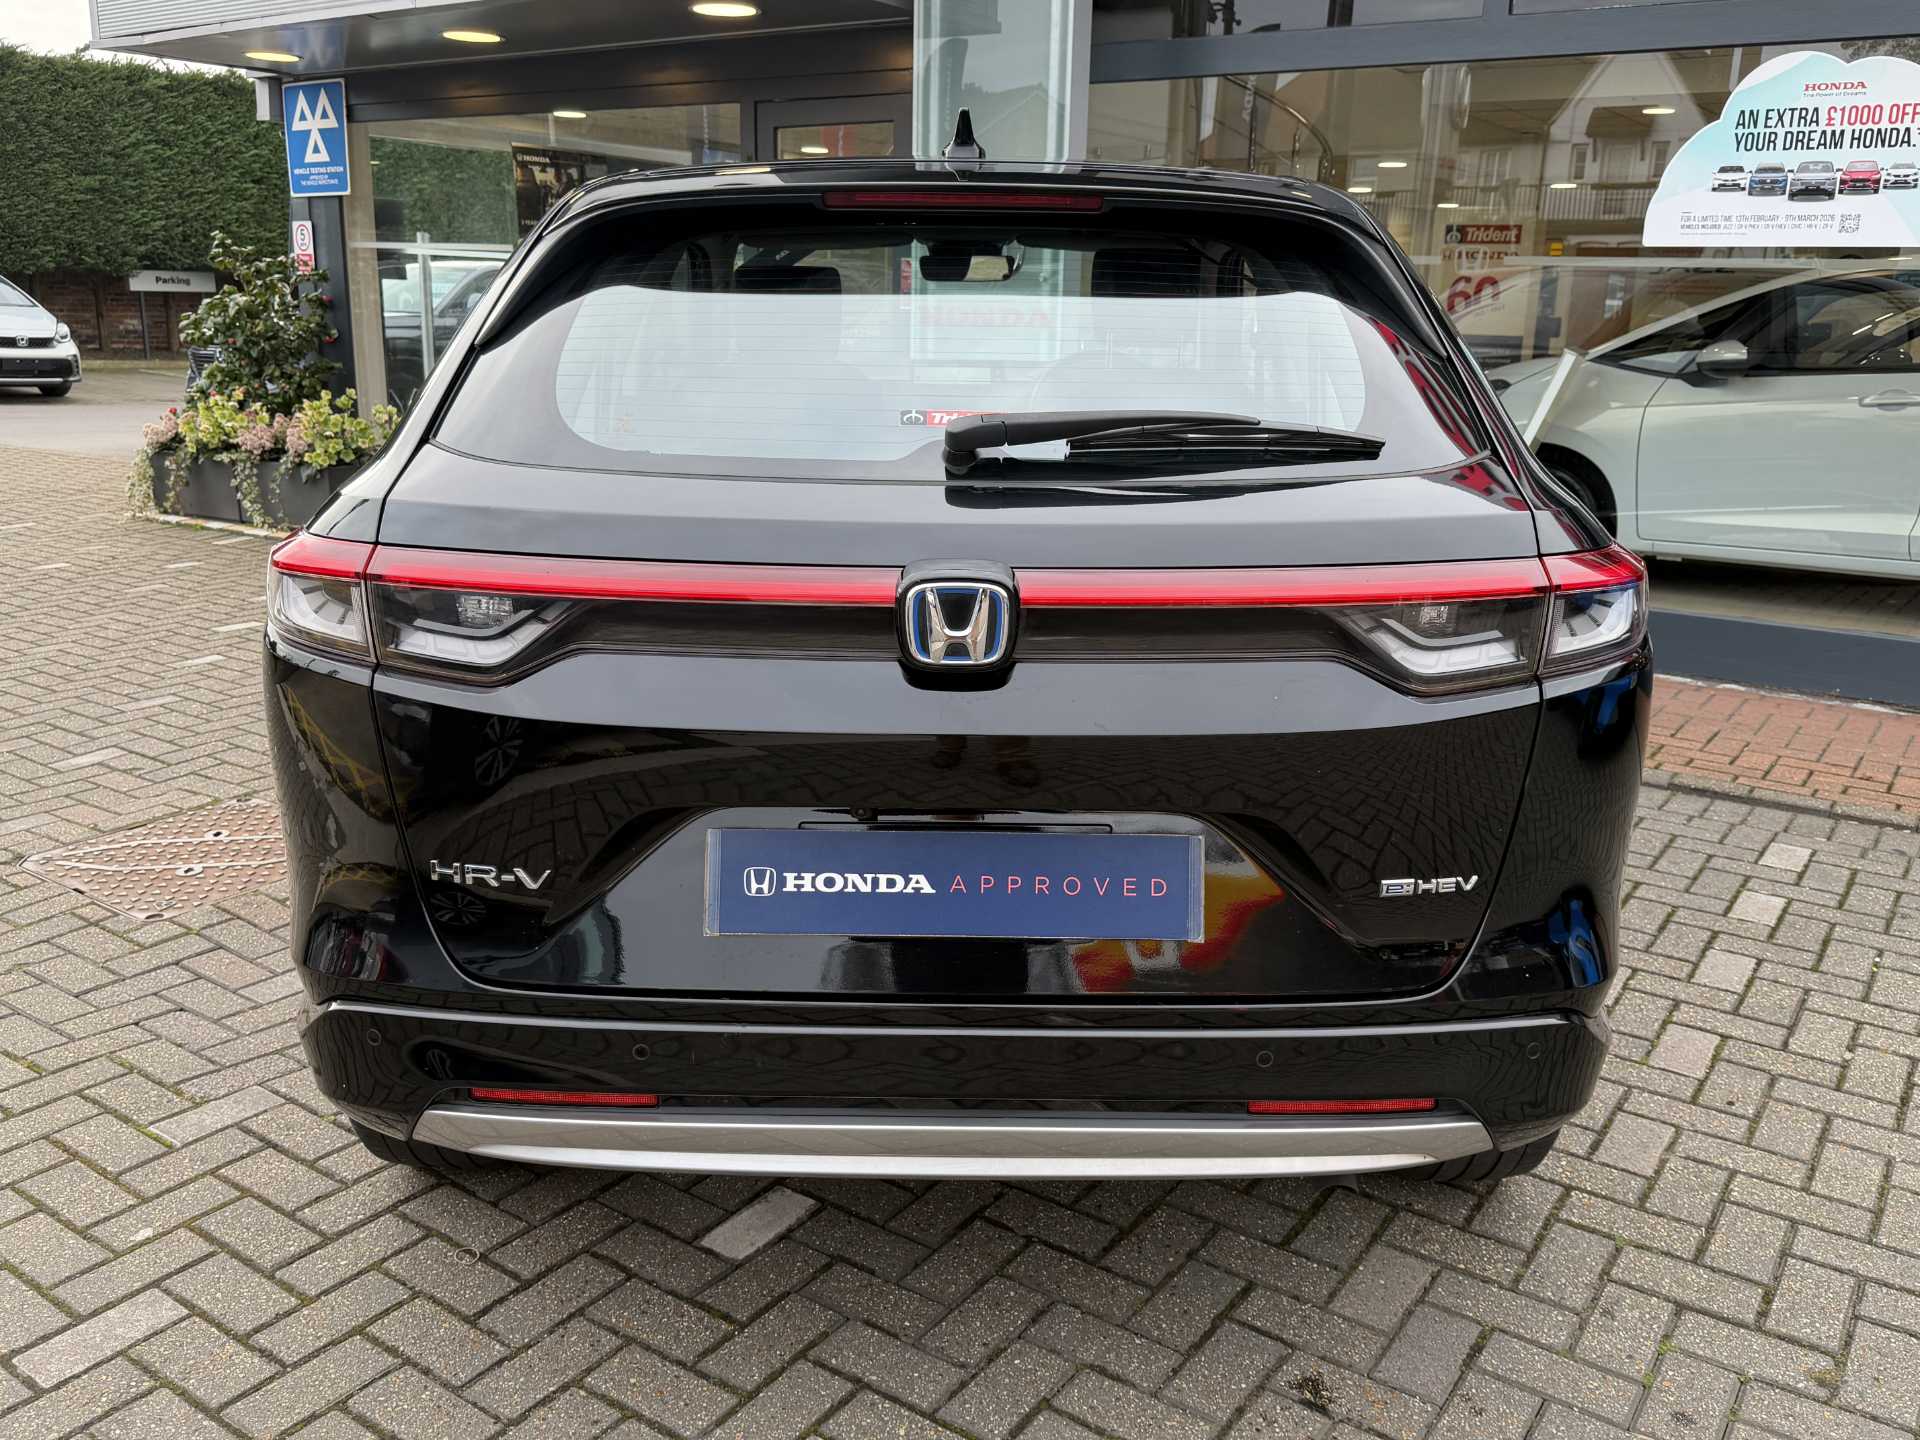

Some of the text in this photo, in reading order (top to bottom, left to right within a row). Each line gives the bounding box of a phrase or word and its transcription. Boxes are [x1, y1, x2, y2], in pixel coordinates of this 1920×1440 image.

[1803, 81, 1868, 92] HONDA
[1735, 102, 1920, 130] AN EXTRA £1000 OFF
[1735, 131, 1778, 152] YOUR
[1782, 129, 1845, 151] DREAM
[523, 155, 550, 163] HONDA
[299, 229, 306, 241] 5
[1465, 227, 1519, 242] Trident
[155, 275, 192, 286] Parking
[429, 859, 552, 890] HR-V
[782, 871, 1168, 897] HONDA APPROVED
